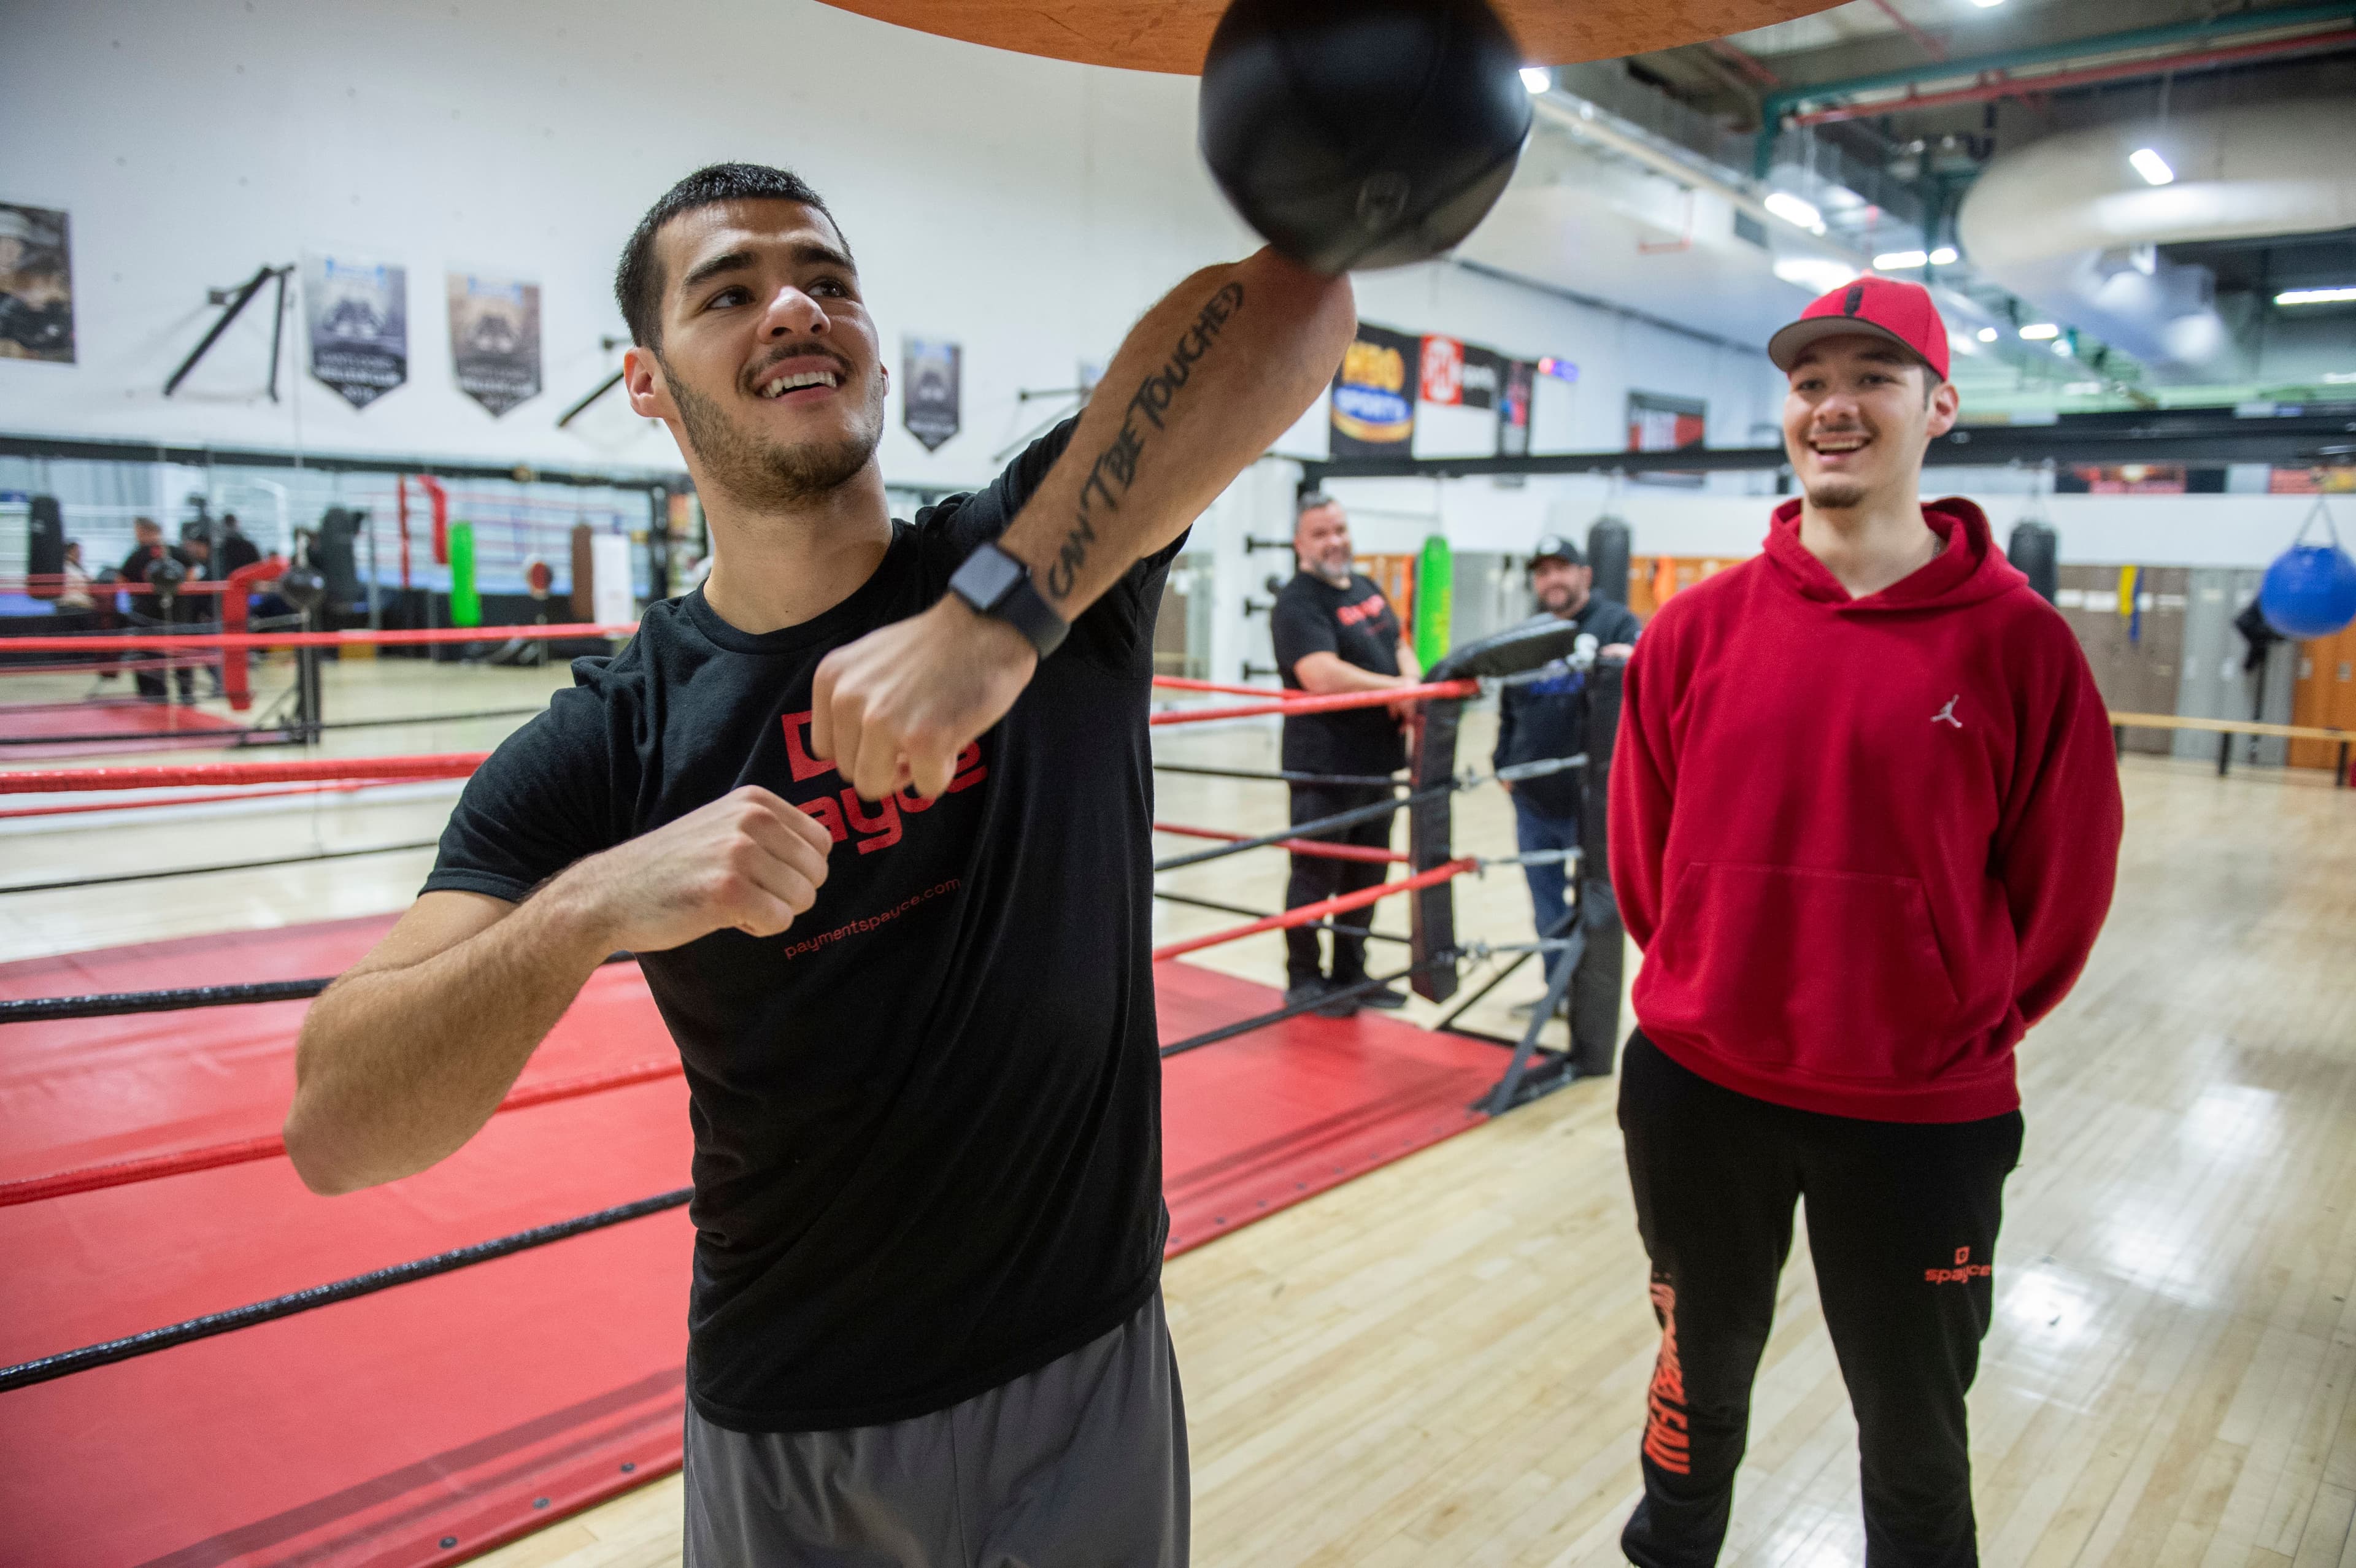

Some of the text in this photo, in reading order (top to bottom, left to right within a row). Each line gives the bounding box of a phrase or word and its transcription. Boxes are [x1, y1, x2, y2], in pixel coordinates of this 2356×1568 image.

[1123, 281, 1244, 430] TOUCHED
[1104, 428, 1146, 491] BE
[783, 878, 962, 960] paymentspayce.com
